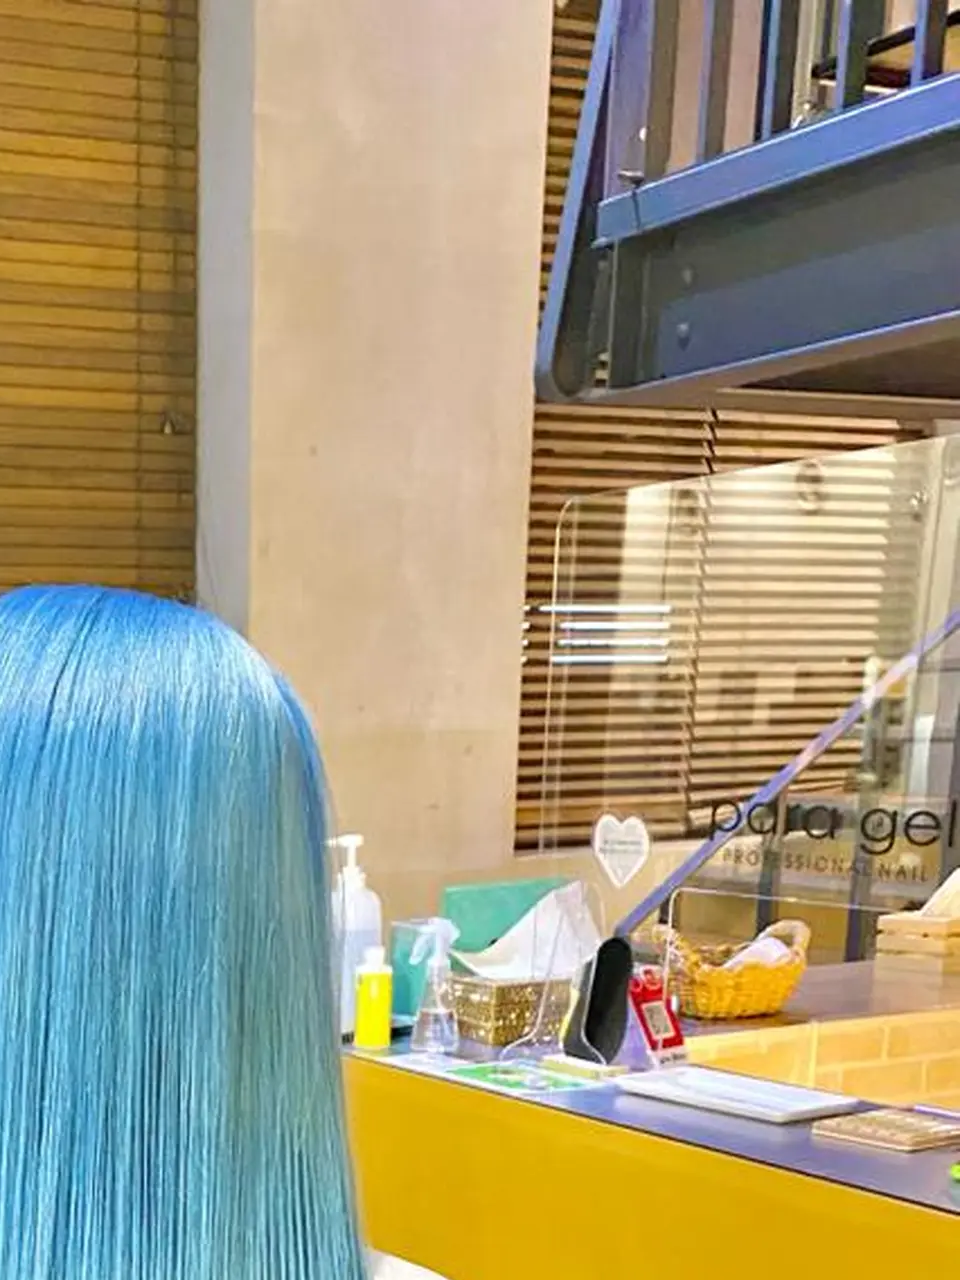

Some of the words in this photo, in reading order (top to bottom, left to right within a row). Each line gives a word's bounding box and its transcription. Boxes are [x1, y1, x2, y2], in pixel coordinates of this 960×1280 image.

[709, 799, 838, 841] para
[860, 800, 957, 855] gel
[878, 863, 928, 882] NAIL
